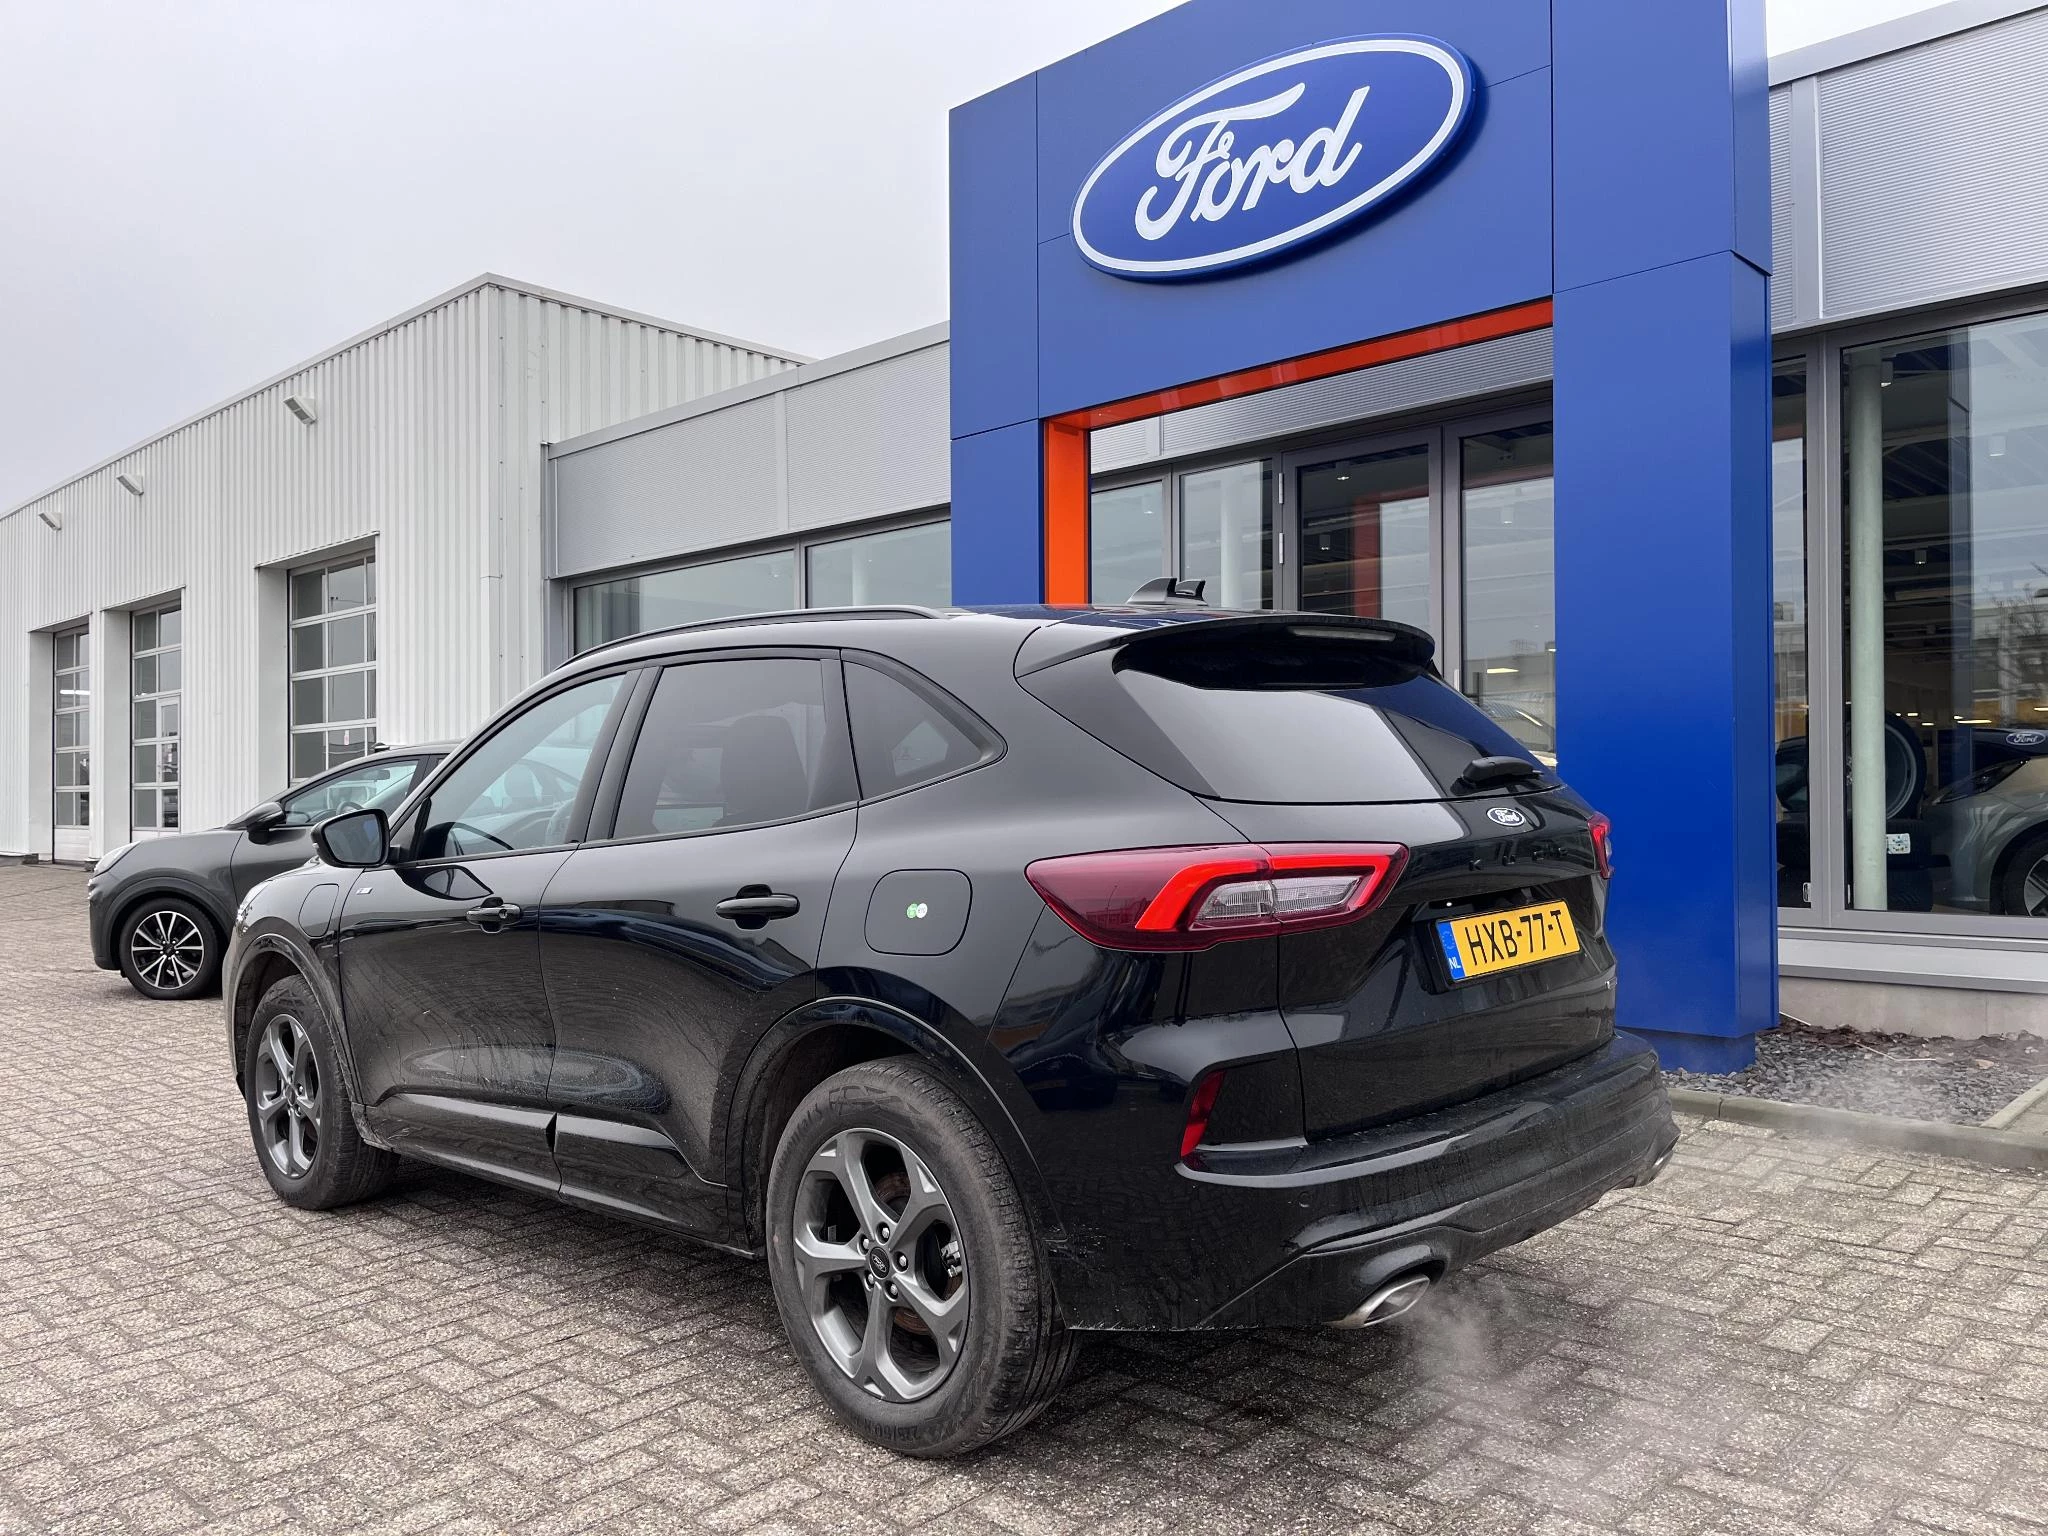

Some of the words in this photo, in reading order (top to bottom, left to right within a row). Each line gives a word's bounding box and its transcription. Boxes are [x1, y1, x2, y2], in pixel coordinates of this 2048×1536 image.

[1134, 82, 1370, 241] Ford
[1448, 956, 1462, 970] NL
[1464, 909, 1567, 966] HXB-77-T
